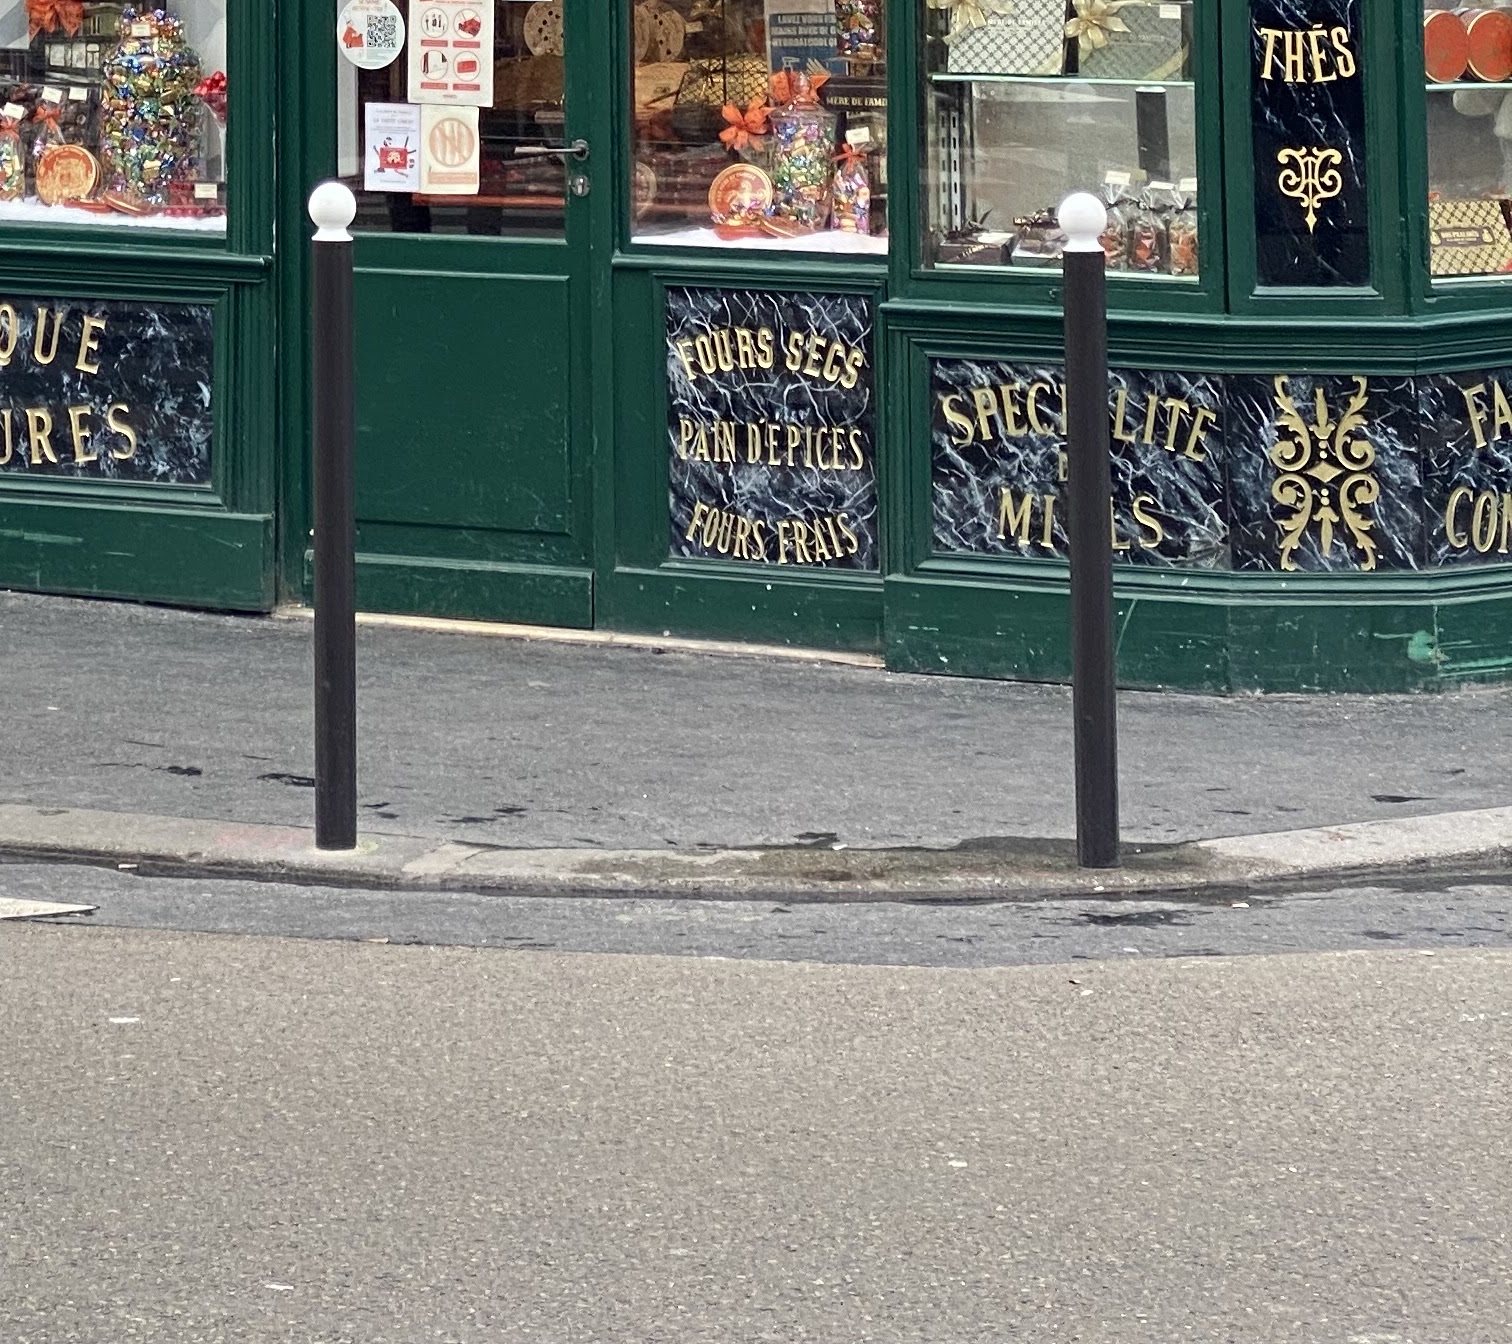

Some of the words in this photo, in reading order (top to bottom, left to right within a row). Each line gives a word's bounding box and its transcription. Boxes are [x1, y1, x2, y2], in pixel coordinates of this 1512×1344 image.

[1260, 23, 1356, 84] THÉS
[676, 325, 775, 382] FOURS
[786, 331, 864, 390] SECS
[678, 418, 737, 464] PAIN
[940, 382, 1217, 462] SPECILITE
[685, 502, 766, 561] FOURS
[776, 512, 859, 564] FRAIS
[997, 487, 1165, 552] MILS
